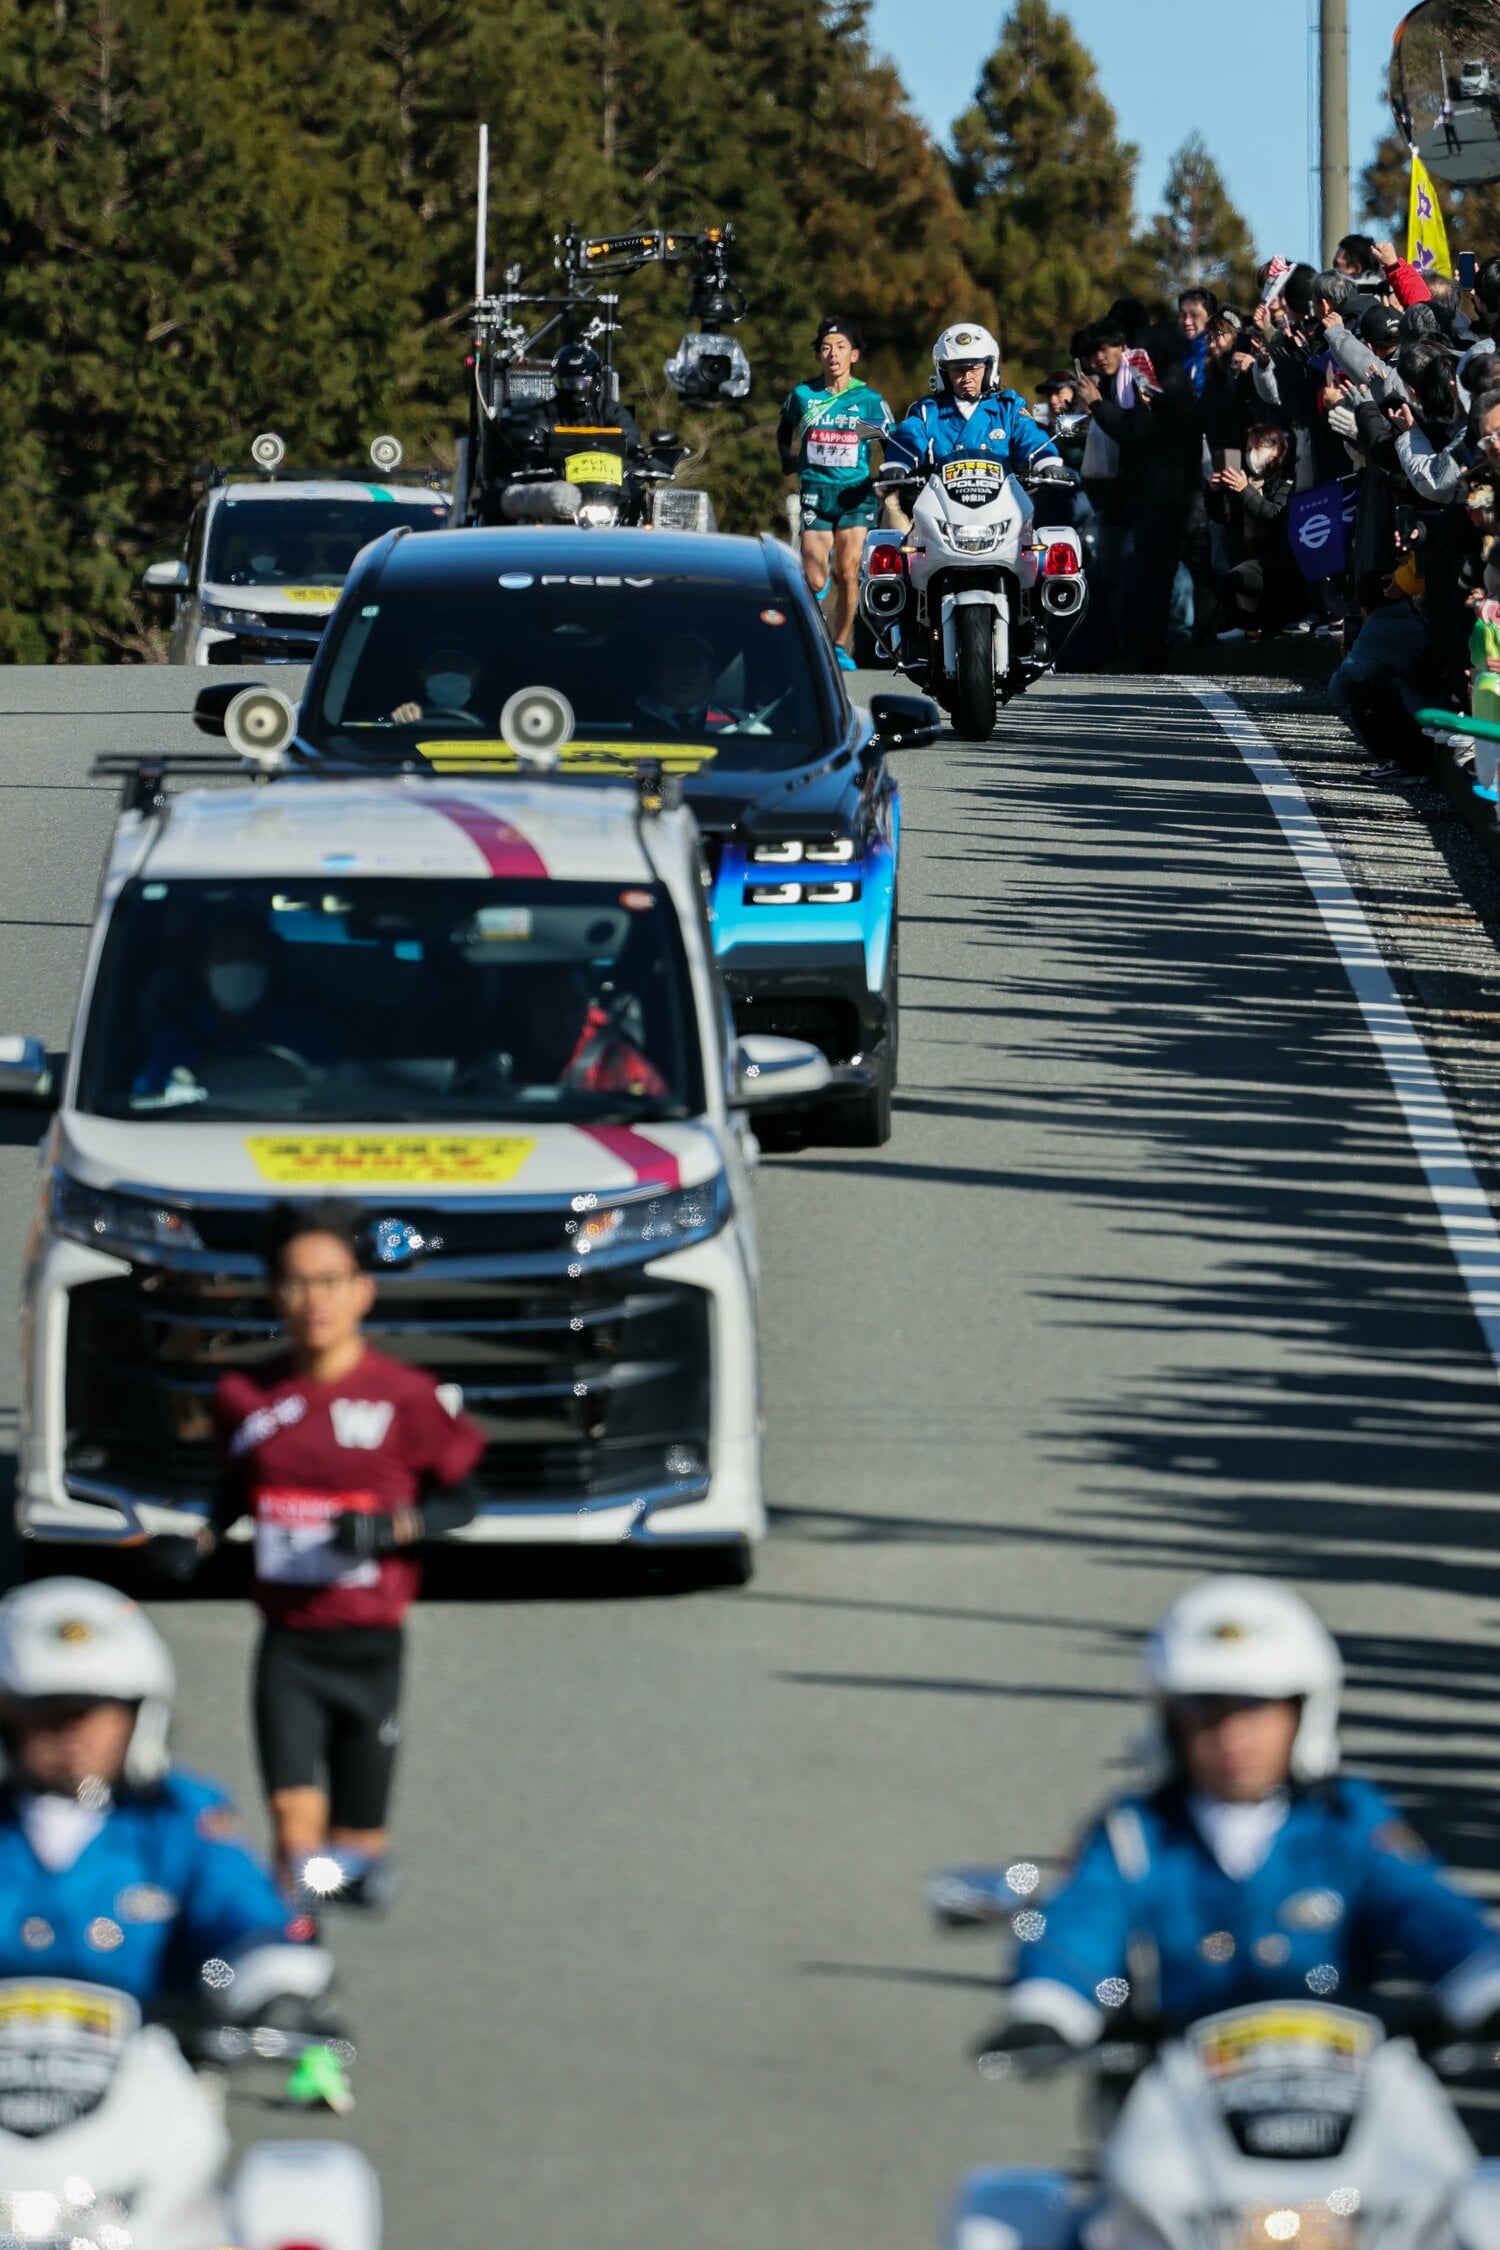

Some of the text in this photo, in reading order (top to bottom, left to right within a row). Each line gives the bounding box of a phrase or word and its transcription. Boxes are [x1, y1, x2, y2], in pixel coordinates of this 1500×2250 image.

[819, 432, 858, 443] SAPPORO
[816, 444, 851, 457] 青学大
[947, 479, 1000, 490] POLICE
[955, 487, 993, 495] HONDA
[961, 493, 986, 503] 神奈川
[541, 575, 654, 588] FCEV
